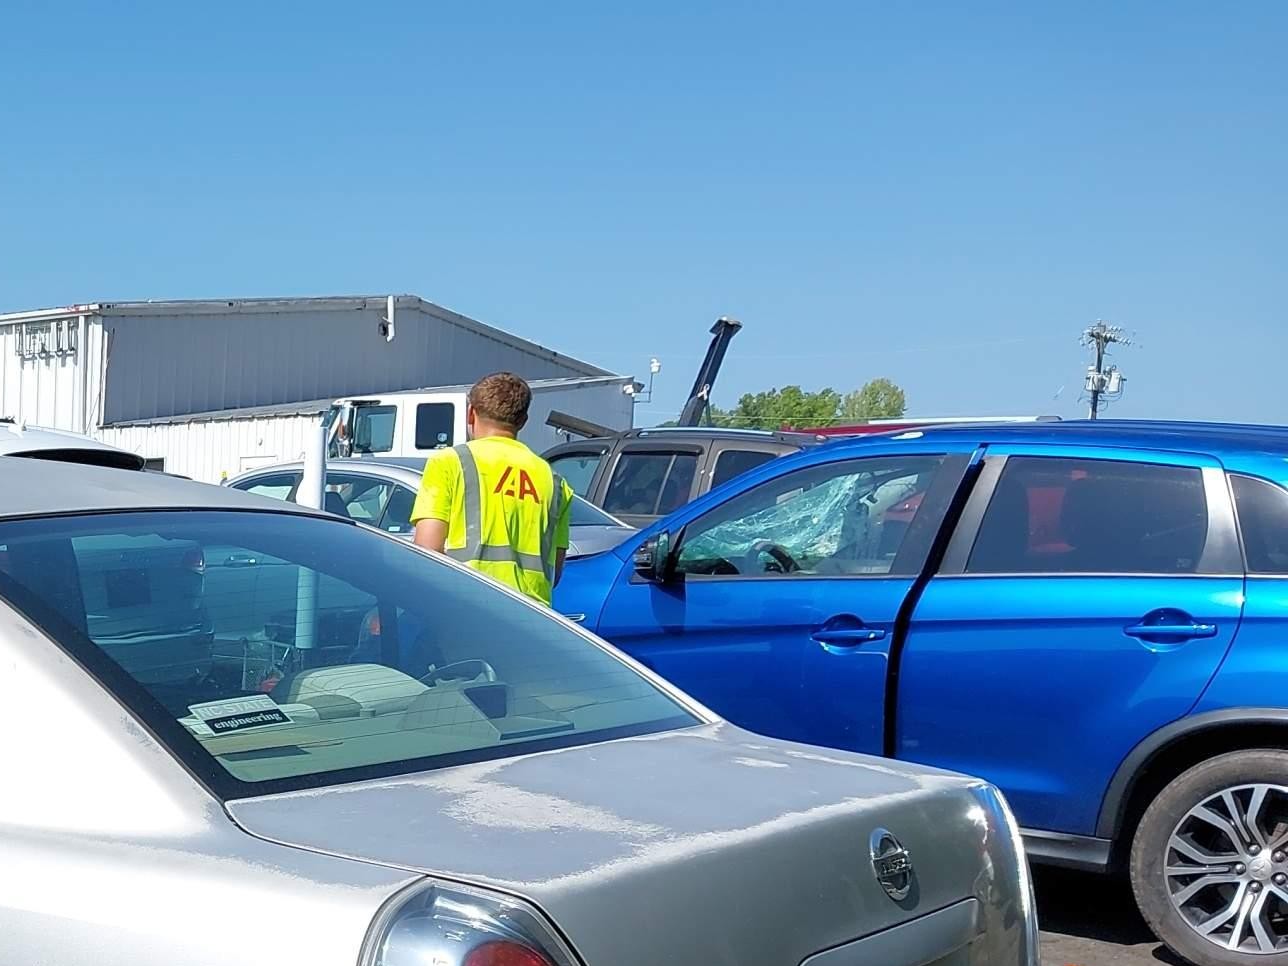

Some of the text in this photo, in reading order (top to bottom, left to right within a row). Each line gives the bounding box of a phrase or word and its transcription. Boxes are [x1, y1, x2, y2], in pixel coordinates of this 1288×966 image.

[198, 699, 273, 718] NC STATE
[214, 712, 283, 729] engineering
